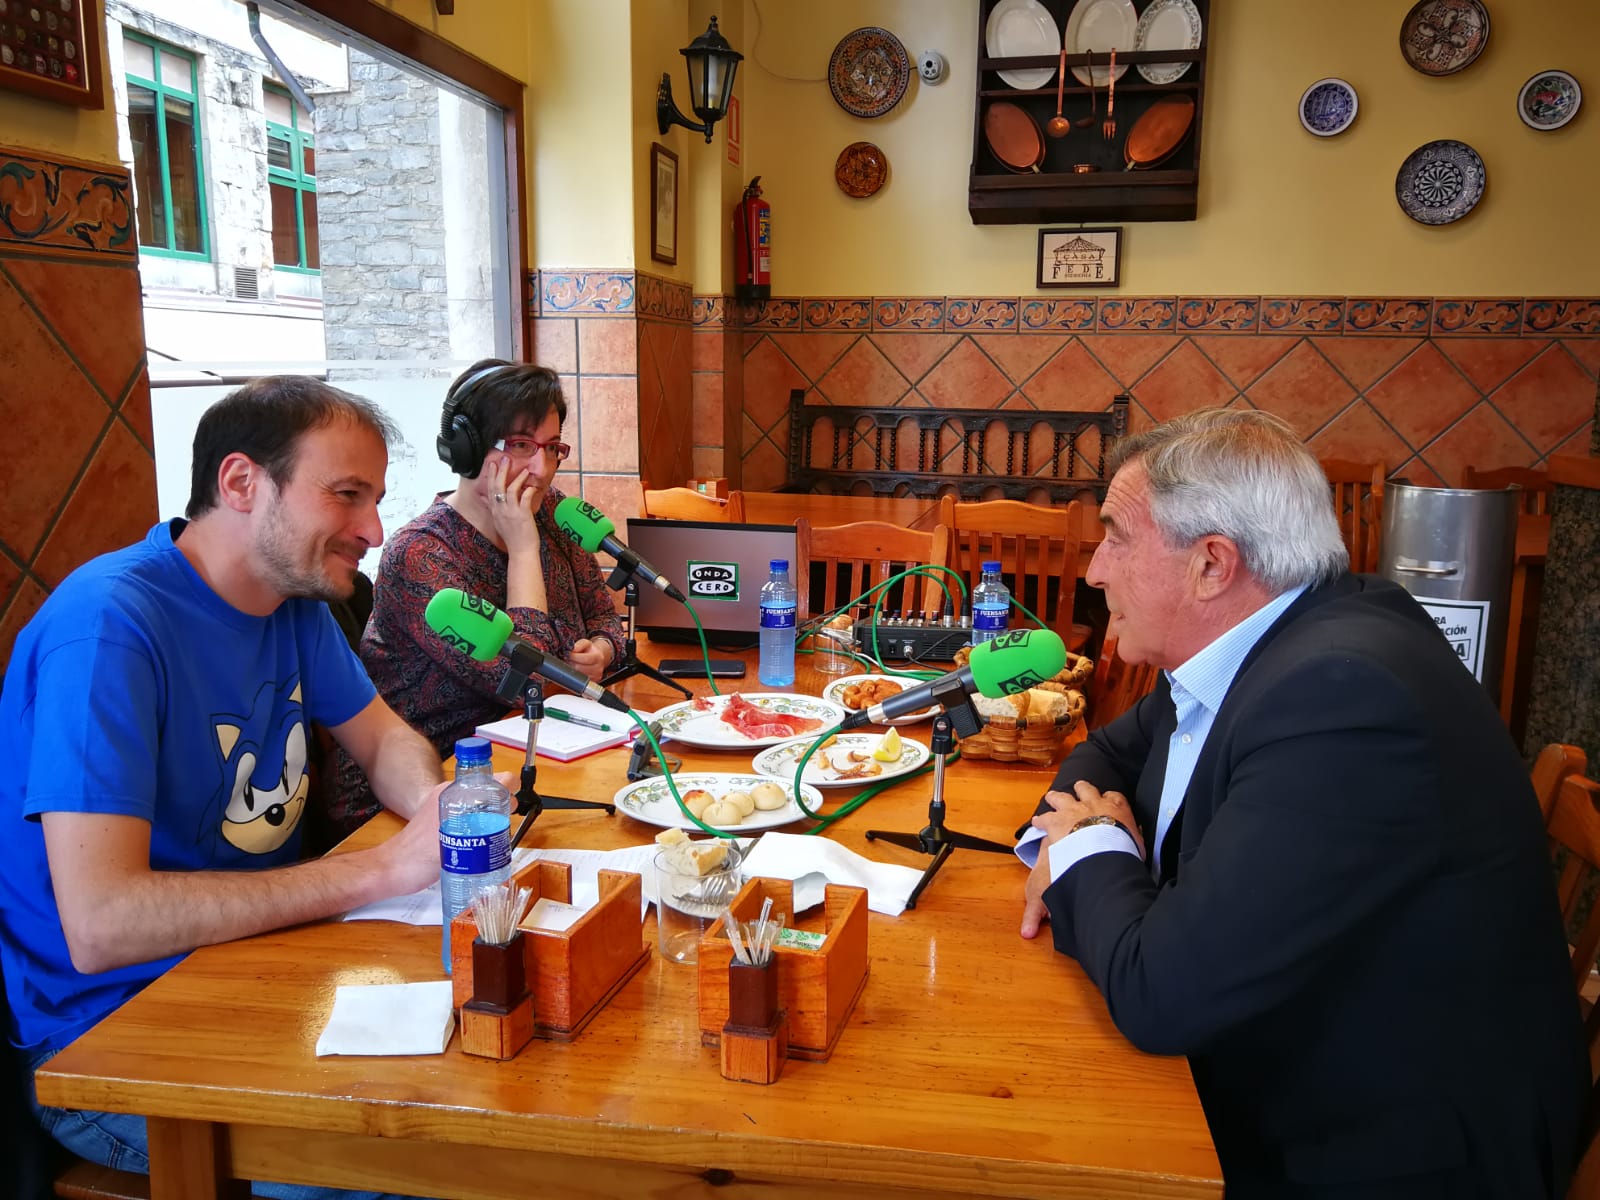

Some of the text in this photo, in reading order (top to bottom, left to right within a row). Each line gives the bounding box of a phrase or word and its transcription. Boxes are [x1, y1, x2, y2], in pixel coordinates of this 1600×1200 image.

[1063, 252, 1096, 260] CASA
[1052, 265, 1104, 279] FEDE
[695, 570, 729, 578] ONDA
[697, 583, 729, 591] CERO
[1441, 625, 1467, 636] CIÓN
